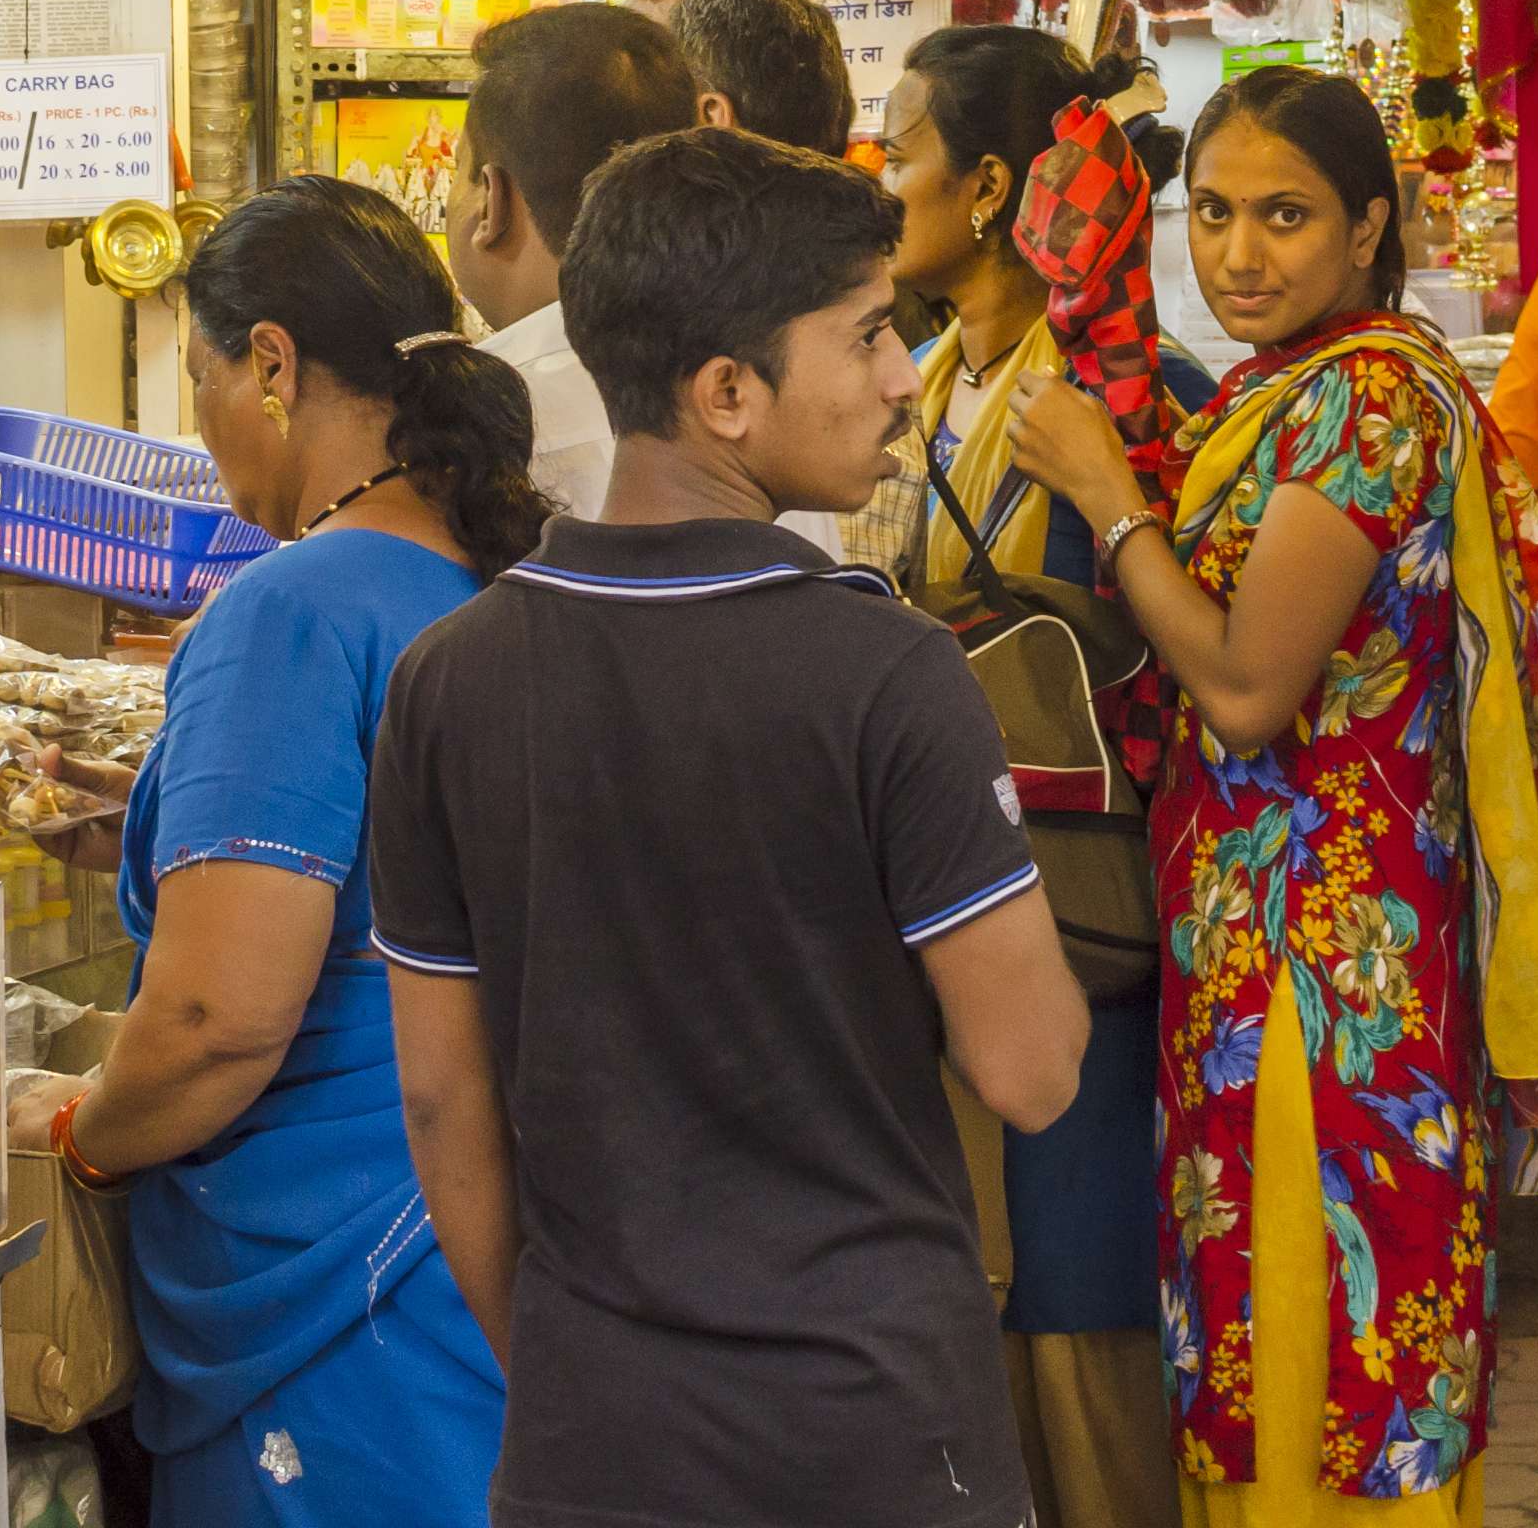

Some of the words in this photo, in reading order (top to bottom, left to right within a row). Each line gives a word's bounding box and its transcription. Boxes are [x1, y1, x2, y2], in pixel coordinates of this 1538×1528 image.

[861, 46, 884, 63] ला
[5, 76, 69, 93] CARRY
[74, 73, 115, 90] BAG
[45, 108, 83, 120] PRICE
[104, 106, 125, 118] PC.
[128, 105, 158, 119] (Rs.)
[36, 135, 55, 151] 16
[80, 133, 100, 150] 20
[117, 131, 152, 148] 6.00
[39, 164, 59, 181] 20
[79, 162, 98, 179] 26
[115, 161, 151, 178] 8.00
